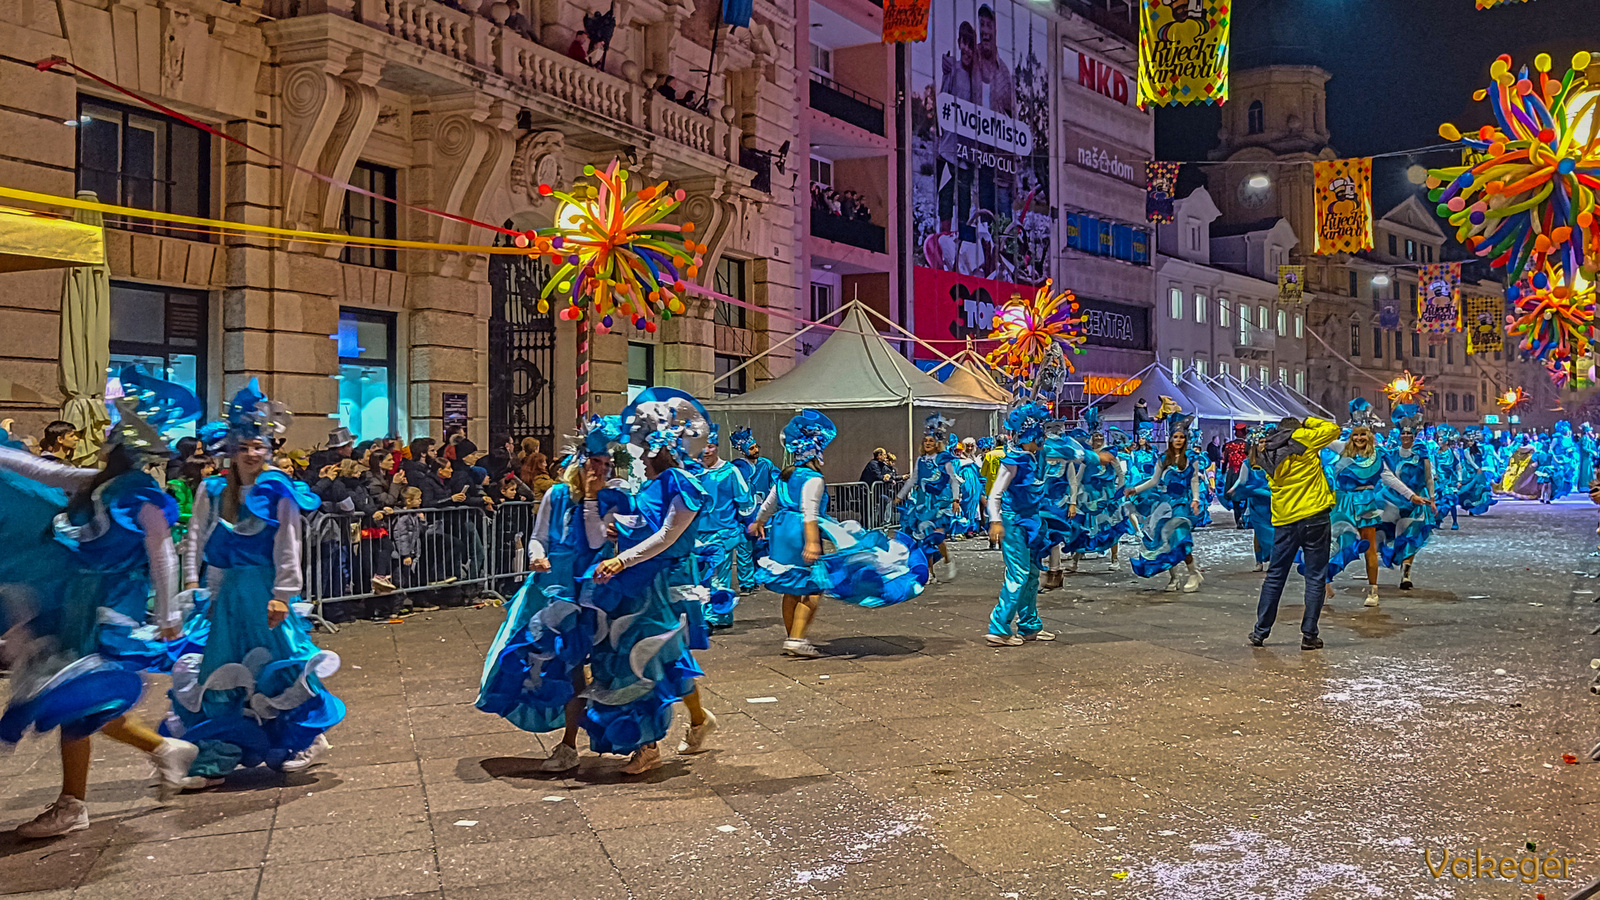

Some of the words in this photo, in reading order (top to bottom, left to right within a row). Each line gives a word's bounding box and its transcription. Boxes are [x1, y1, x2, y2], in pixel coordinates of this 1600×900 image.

[1079, 52, 1128, 106] NKD
[942, 102, 1027, 147] #TvojeMisto
[956, 143, 969, 160] ZA
[970, 147, 1018, 174] TRADCIJU
[1078, 146, 1098, 169] naš
[1110, 155, 1134, 181] dom
[1320, 225, 1363, 240] karneva
